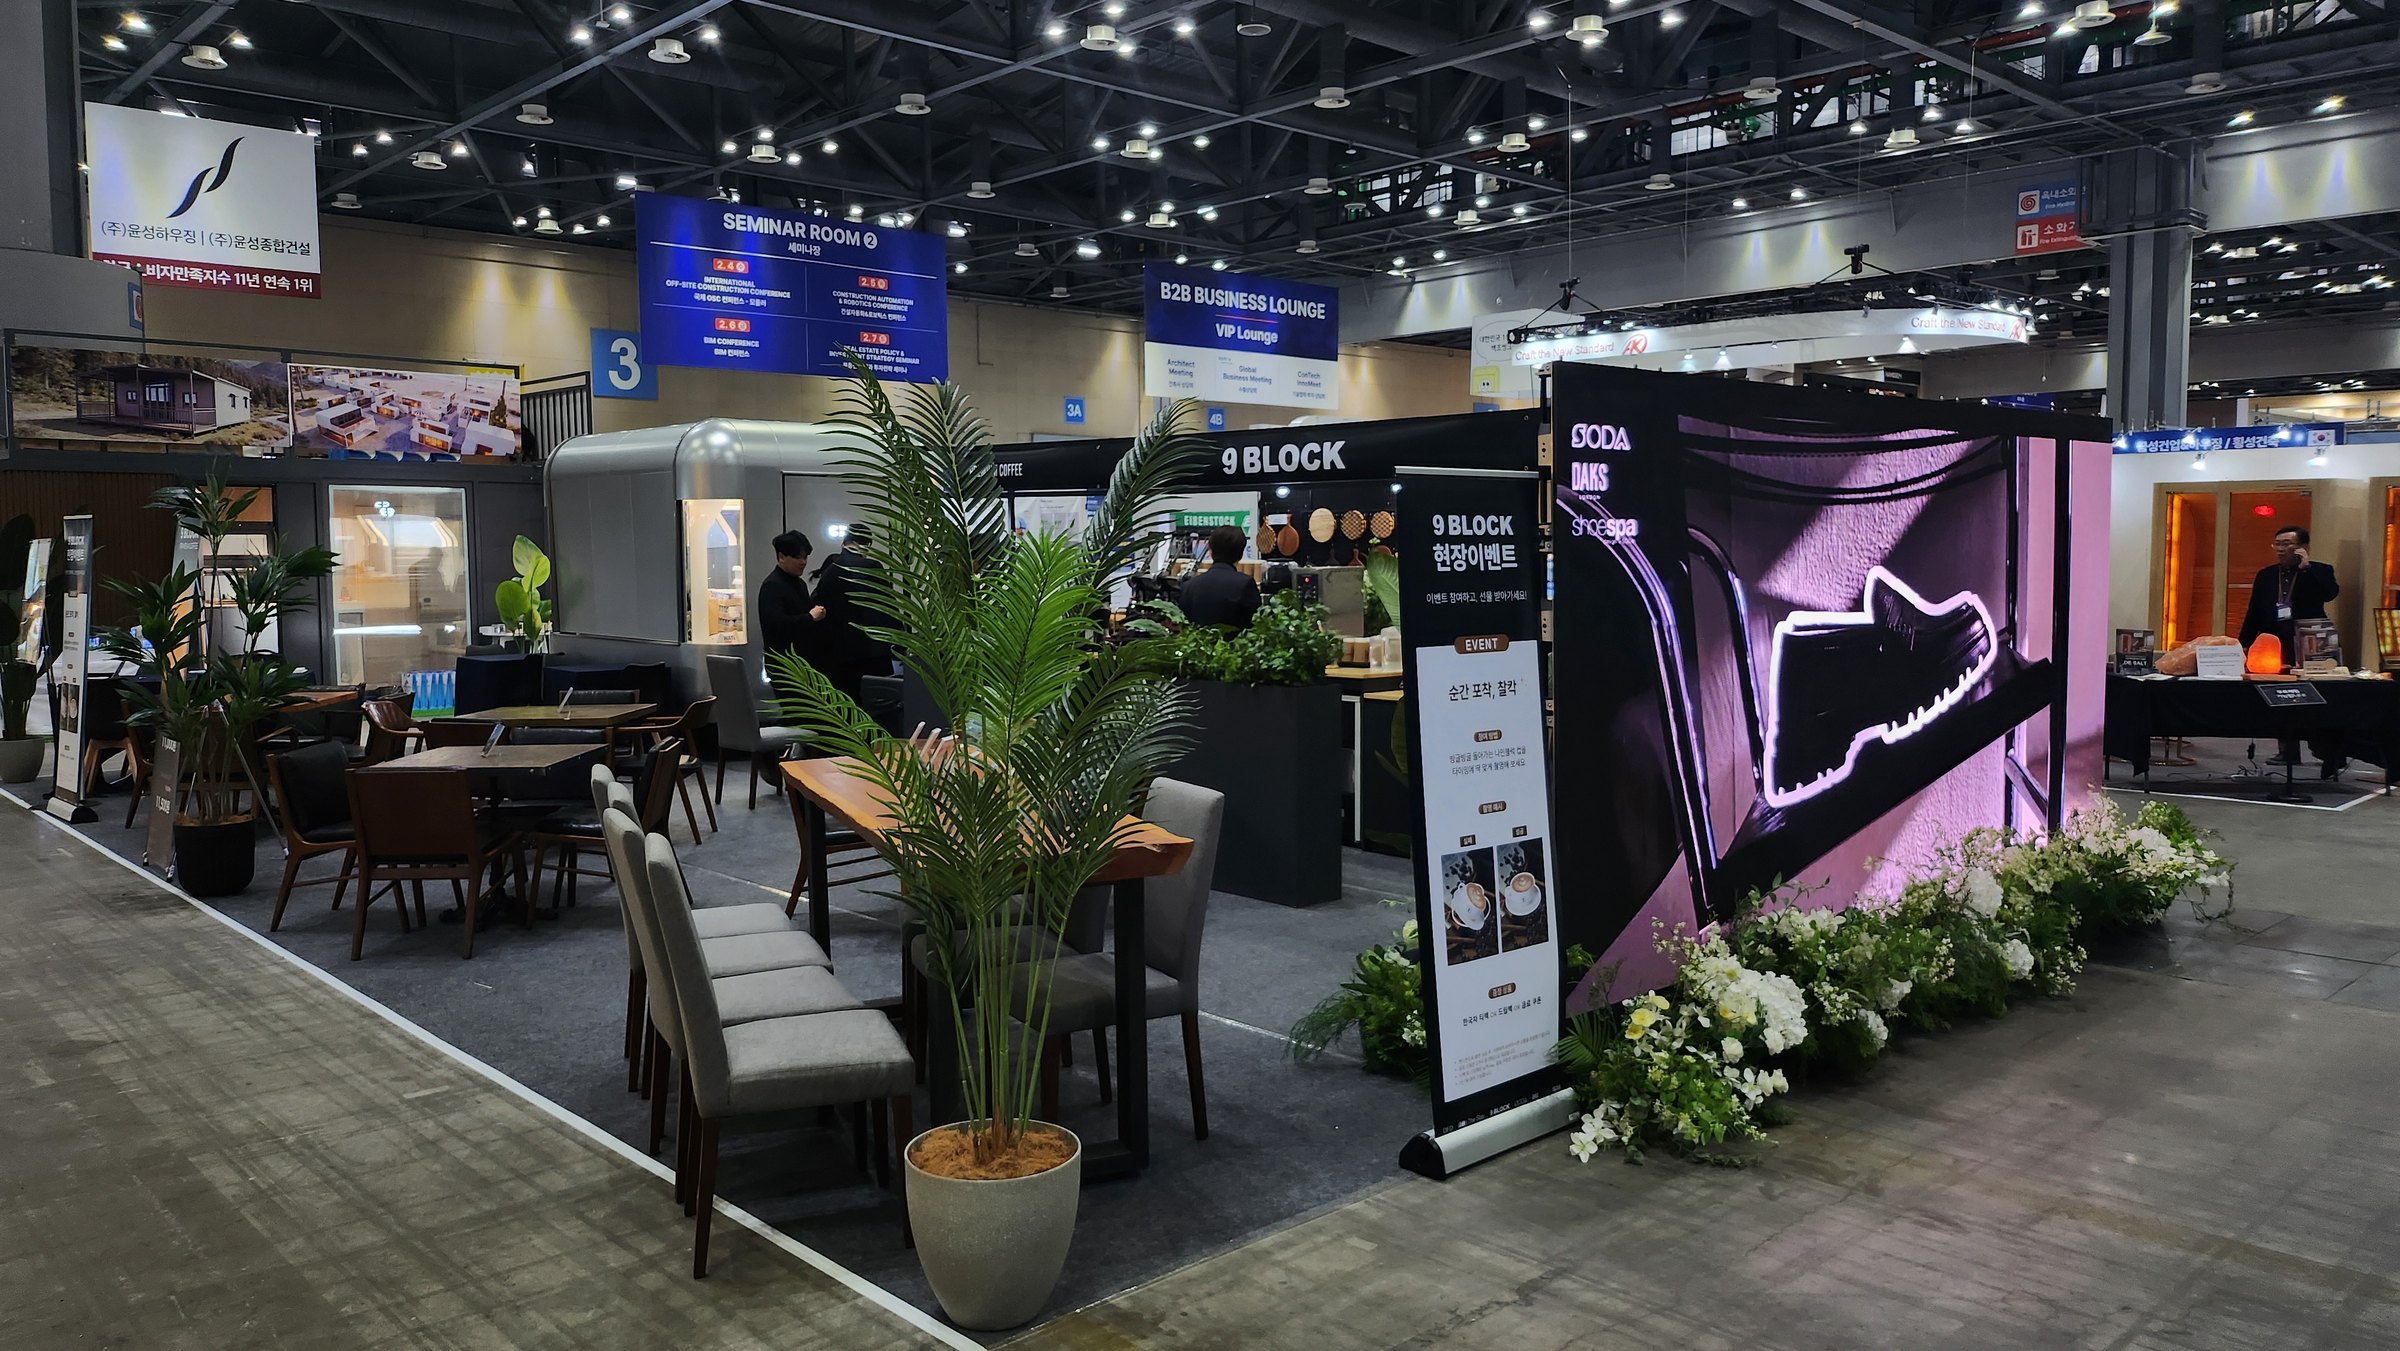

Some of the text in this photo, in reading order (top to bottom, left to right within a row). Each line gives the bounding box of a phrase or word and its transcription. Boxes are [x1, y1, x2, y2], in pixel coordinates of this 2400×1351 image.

[723, 212, 807, 239] SEMINAR
[810, 224, 860, 247] ROOM
[101, 221, 196, 244] (주)윤성하우징
[209, 232, 311, 257] (주)윤성종합건설
[788, 242, 821, 257] 세미나장
[234, 272, 261, 288] 11년
[263, 275, 291, 291] 연속
[293, 279, 313, 293] 1위
[666, 280, 791, 298] OFF-SITE CONSTRUCTION CONFERENCE
[704, 276, 756, 288] INTERNATIONAL
[832, 290, 914, 306] CONSTRUCTION AUTOMATION
[843, 299, 872, 308] ROBOTICS
[872, 301, 908, 312] CONFERENCE
[1160, 281, 1326, 320] B2B BUSINESS LOUNGE
[1911, 317, 1938, 328] Craft
[1940, 318, 1956, 328] the
[1958, 318, 1975, 329] New
[1216, 323, 1278, 345] VIP Lounge
[717, 337, 759, 348] CONFERENCE
[859, 346, 879, 355] ESTATE
[880, 348, 900, 357] POLICY
[1516, 350, 1536, 361] Craft
[1538, 349, 1551, 359] the
[1553, 346, 1572, 357] New
[1575, 342, 1614, 355] Standard
[608, 337, 641, 390] 3
[866, 354, 895, 363] STRATEGY
[896, 357, 920, 365] SEMINAR
[1167, 359, 1195, 368] Architect
[1169, 368, 1193, 377] Meeting
[1239, 365, 1256, 373] Global
[1298, 371, 1320, 379] ConTech
[1223, 373, 1272, 385] Business Meeting
[1067, 402, 1081, 417] 3A
[1210, 413, 1223, 425] 4B
[1571, 423, 1631, 451] SODA
[1221, 440, 1346, 475] 9 BLOCK
[999, 463, 1023, 477] COFFEE
[1571, 462, 1609, 491] DAKS
[1184, 515, 1235, 526] EIBENSTOCK
[1432, 514, 1514, 536] 9 BLOCK
[1432, 543, 1518, 572] 현장이벤트
[1426, 590, 1527, 604] 이벤트 참여하고, 선물 받아가세요!
[1465, 638, 1498, 651] EVENT
[1449, 680, 1517, 701] 순간 포착, 찰칵
